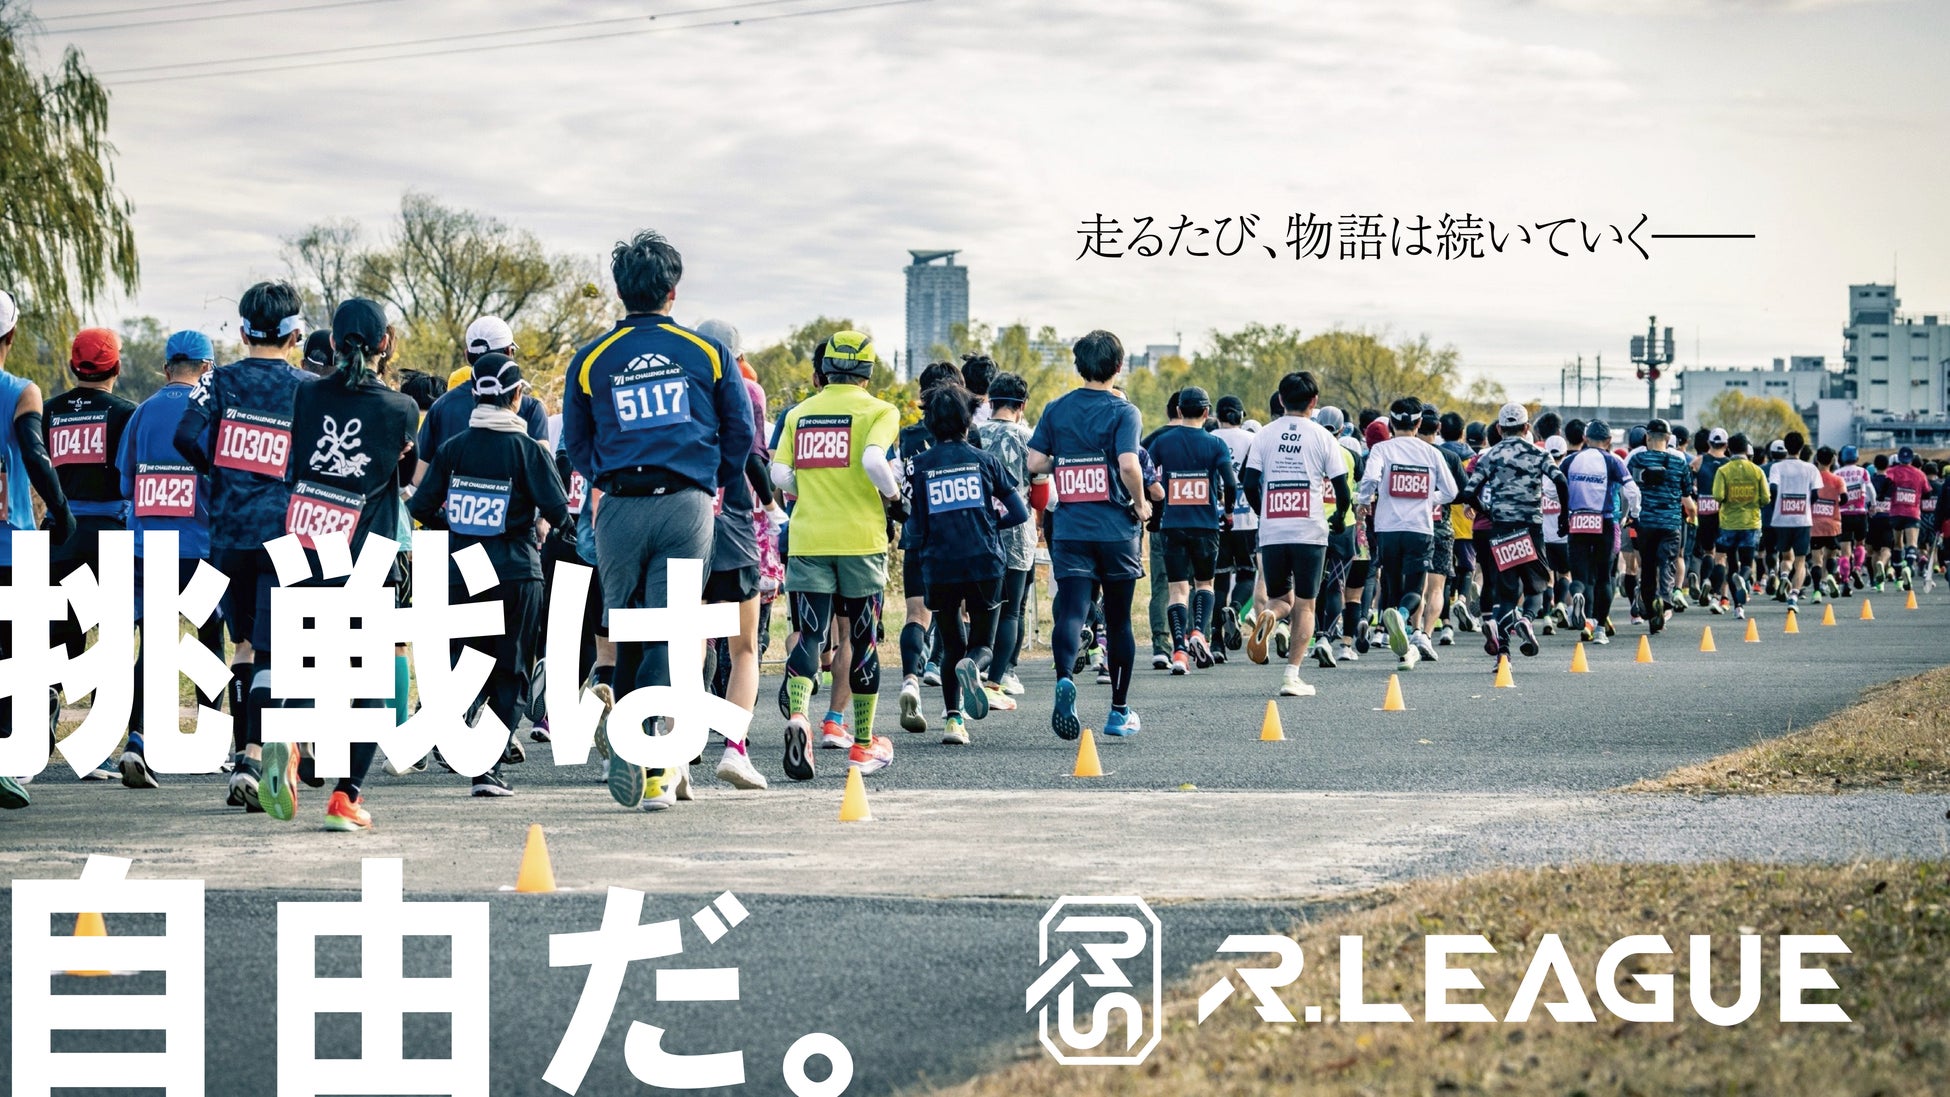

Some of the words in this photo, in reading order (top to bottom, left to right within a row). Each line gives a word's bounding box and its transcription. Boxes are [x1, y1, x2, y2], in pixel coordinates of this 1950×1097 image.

[635, 370, 665, 380] CHALLENGE
[615, 381, 684, 421] 5117
[246, 414, 277, 424] CHALLENGE
[53, 427, 103, 458] 10414
[220, 425, 288, 466] 10309
[797, 431, 849, 460] 10286
[1281, 432, 1302, 441] GO!
[1278, 444, 1302, 454] RUN
[929, 476, 981, 506] 5066
[1059, 468, 1107, 495] 10408
[1172, 480, 1207, 500] 140
[1391, 474, 1428, 494] 10364
[138, 478, 194, 508] 10423
[315, 489, 346, 503] CHALLENGE
[346, 498, 360, 506] RACE
[1269, 491, 1309, 513] 10321
[448, 493, 506, 527] 5023
[1782, 499, 1806, 512] 10347
[1572, 515, 1602, 529] 10268
[1495, 538, 1534, 565] 10288
